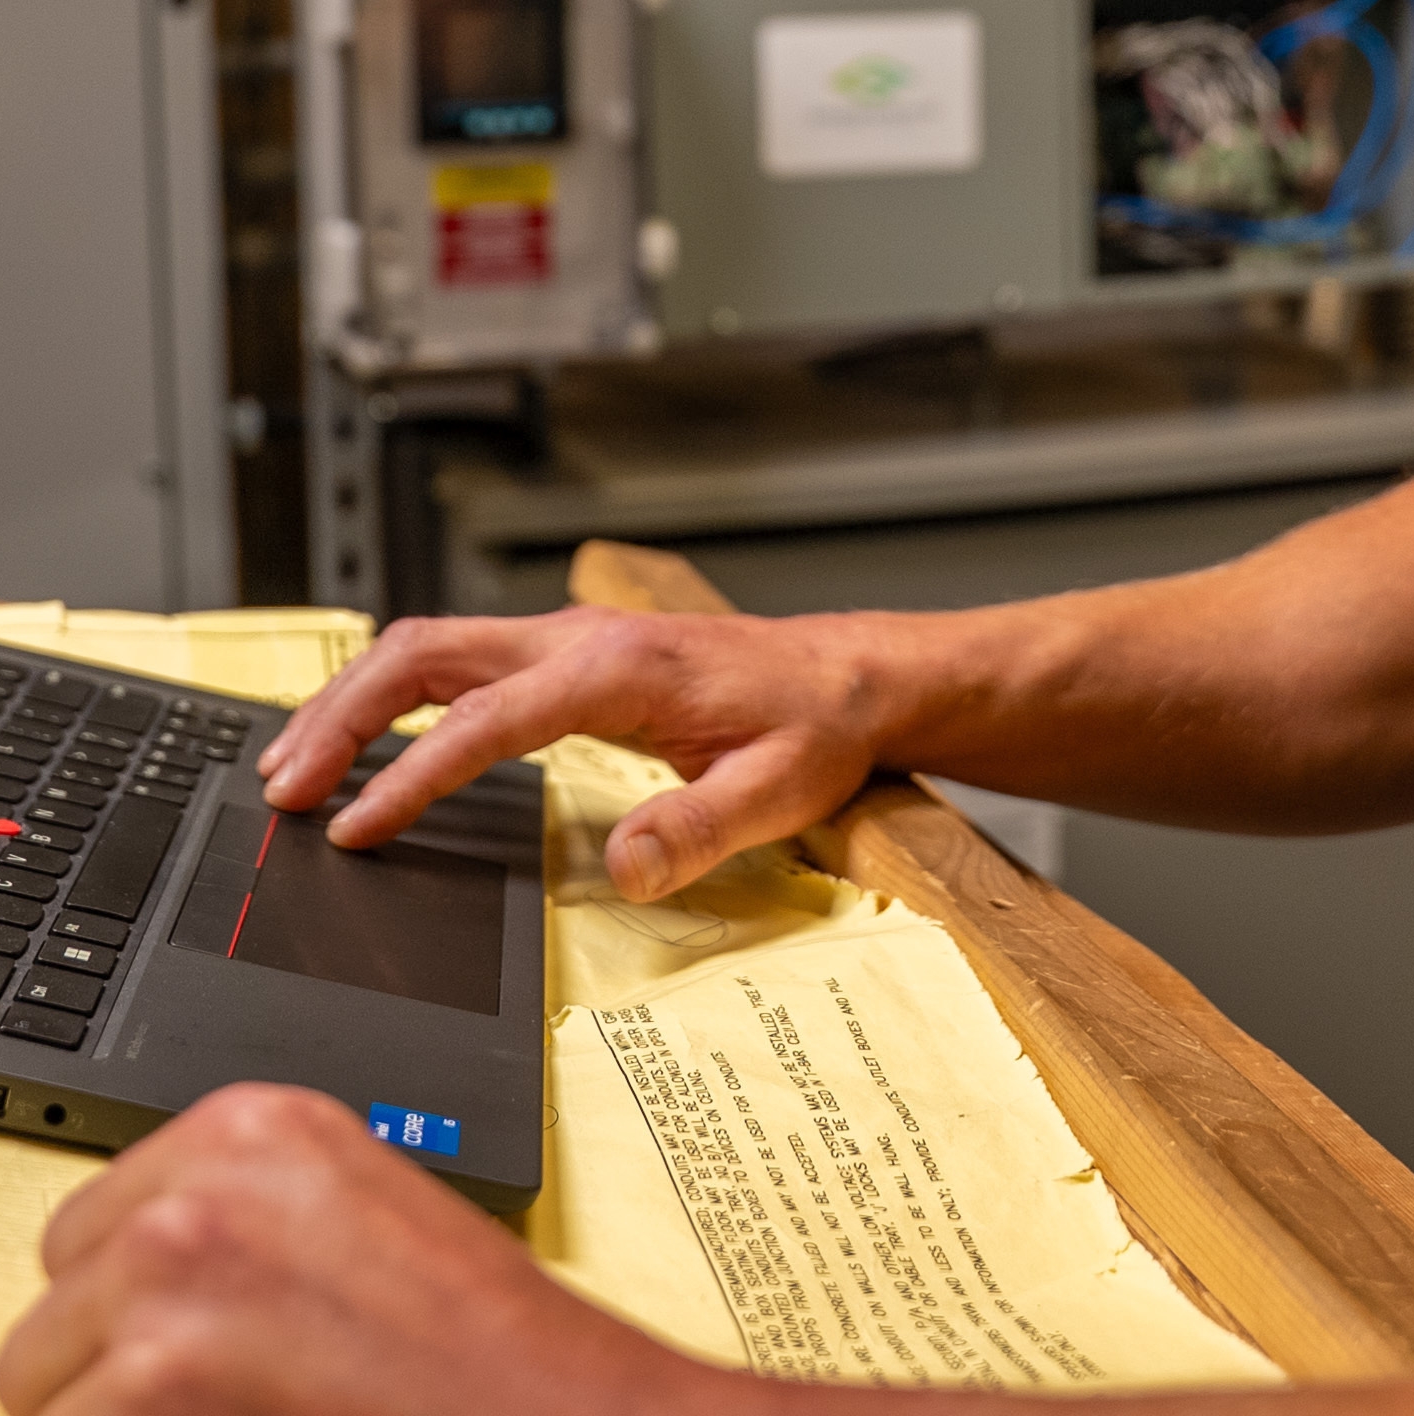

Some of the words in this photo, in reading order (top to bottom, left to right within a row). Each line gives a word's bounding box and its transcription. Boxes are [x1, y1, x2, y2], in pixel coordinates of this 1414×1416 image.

[6, 853, 27, 863] V
[822, 980, 842, 991] PULL
[834, 998, 854, 1015] AND
[626, 1029, 649, 1047] OTHER
[646, 1029, 666, 1044] OPEN
[758, 1013, 790, 1056] INSTALLED
[845, 1020, 870, 1050] BOXES
[641, 1054, 658, 1062] ALL
[780, 1061, 798, 1071] BE
[623, 1057, 652, 1089] INSTALLED
[663, 1061, 691, 1096] ALLOWED
[862, 1055, 889, 1086] OUTLET
[686, 1071, 713, 1102] CEILING.
[789, 1075, 809, 1088] NOT
[643, 1095, 660, 1103] BE
[682, 1101, 699, 1111] BE
[732, 1096, 752, 1112] FOR
[801, 1092, 821, 1109] MAY
[817, 1090, 840, 1110] USED
[650, 1110, 669, 1126] NOT
[670, 1115, 690, 1132] FOR
[704, 1110, 721, 1120] ON
[691, 1120, 710, 1135] WILL
[743, 1119, 766, 1140] USED
[832, 1120, 850, 1130] BE
[661, 1132, 679, 1147] MAY
[712, 1128, 741, 1163] DEVICES
[813, 1118, 845, 1157] SYSTEMS
[841, 1138, 861, 1154] MAY
[681, 1140, 703, 1159] USED
[756, 1147, 775, 1159] BE
[786, 1135, 821, 1183] ACCEPTED.
[875, 1136, 901, 1165] HUNG.
[911, 1138, 944, 1180] PROVIDE
[671, 1154, 702, 1199] CONDUITS
[694, 1166, 712, 1177] BE
[713, 1166, 730, 1177] NO
[732, 1171, 749, 1181] TO
[765, 1165, 787, 1186] NOT
[835, 1164, 867, 1206] VOLTAGE
[893, 1175, 915, 1197] WALL
[704, 1187, 723, 1203] MAY
[722, 1188, 744, 1209] TRAY.
[740, 1188, 768, 1219] BOXES
[777, 1192, 798, 1211] MAY
[810, 1190, 830, 1203] BE
[936, 1189, 961, 1219] ONLY;
[820, 1210, 843, 1229] NOT
[907, 1204, 925, 1218] BE
[713, 1211, 739, 1240] FLOOR
[735, 1219, 754, 1231] OR
[790, 1217, 811, 1235] AND
[858, 1214, 881, 1234] LOW
[918, 1226, 934, 1235] TO
[881, 1223, 905, 1246] TRAY.
[758, 1227, 793, 1273] JUNCTION
[835, 1237, 856, 1254] WILL
[694, 1208, 751, 1304] PREMANUFACTURED;
[745, 1240, 781, 1284] CONDUITS
[802, 1242, 830, 1274] FILLED
[872, 1242, 901, 1274] OTHER
[927, 1245, 952, 1269] LESS
[953, 1227, 1002, 1292] INFORMATION
[731, 1249, 762, 1286] SEATING
[896, 1255, 926, 1285] CABLE
[847, 1263, 875, 1293] WALLS
[945, 1277, 967, 1295] AND
[784, 1279, 810, 1308] FROM
[892, 1281, 916, 1299] AND
[917, 1292, 938, 1305] OR
[752, 1293, 775, 1315] BOX
[821, 1281, 860, 1337] CONCRETE
[867, 1301, 887, 1314] ON
[994, 1299, 1017, 1311] FOR
[742, 1314, 759, 1322] IS
[771, 1293, 807, 1346] MOUNTED
[765, 1326, 788, 1347] AND
[800, 1318, 831, 1355] DROPS
[878, 1323, 915, 1358] CONDUIT
[851, 1345, 874, 1362] ARE
